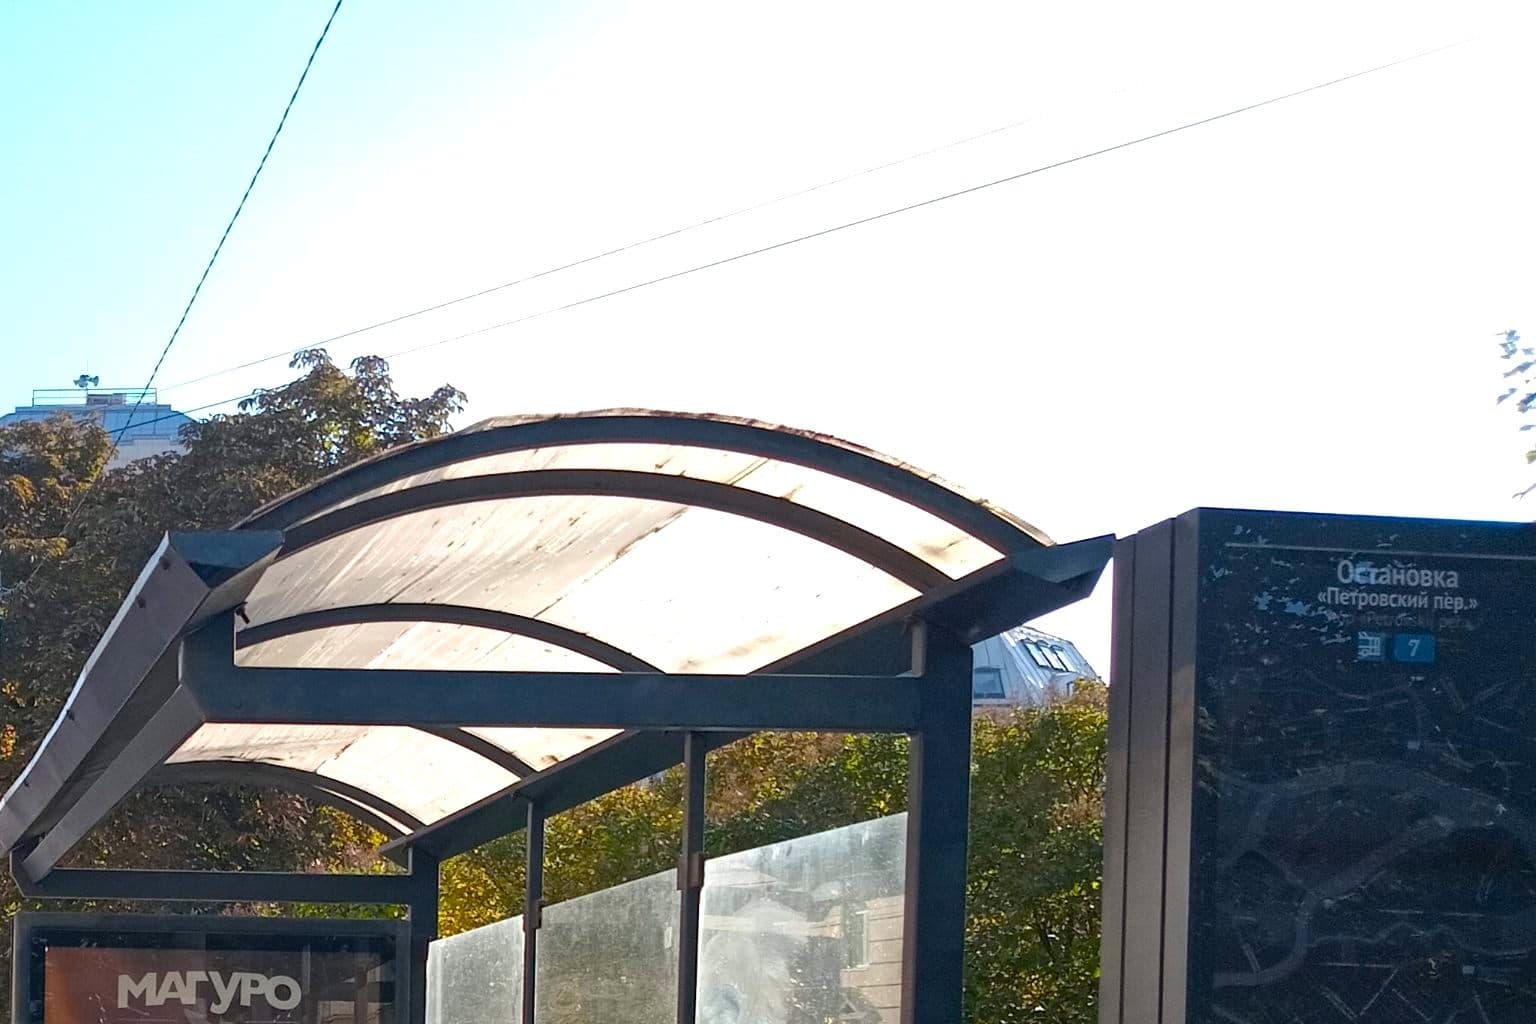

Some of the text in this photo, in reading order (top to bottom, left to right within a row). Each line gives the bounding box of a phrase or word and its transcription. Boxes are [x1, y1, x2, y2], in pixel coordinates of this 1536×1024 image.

[1336, 559, 1459, 589] Остановка
[1317, 587, 1478, 614] «Петровский пер.»
[1407, 639, 1421, 657] 7
[116, 970, 302, 1015] МАГУРО
